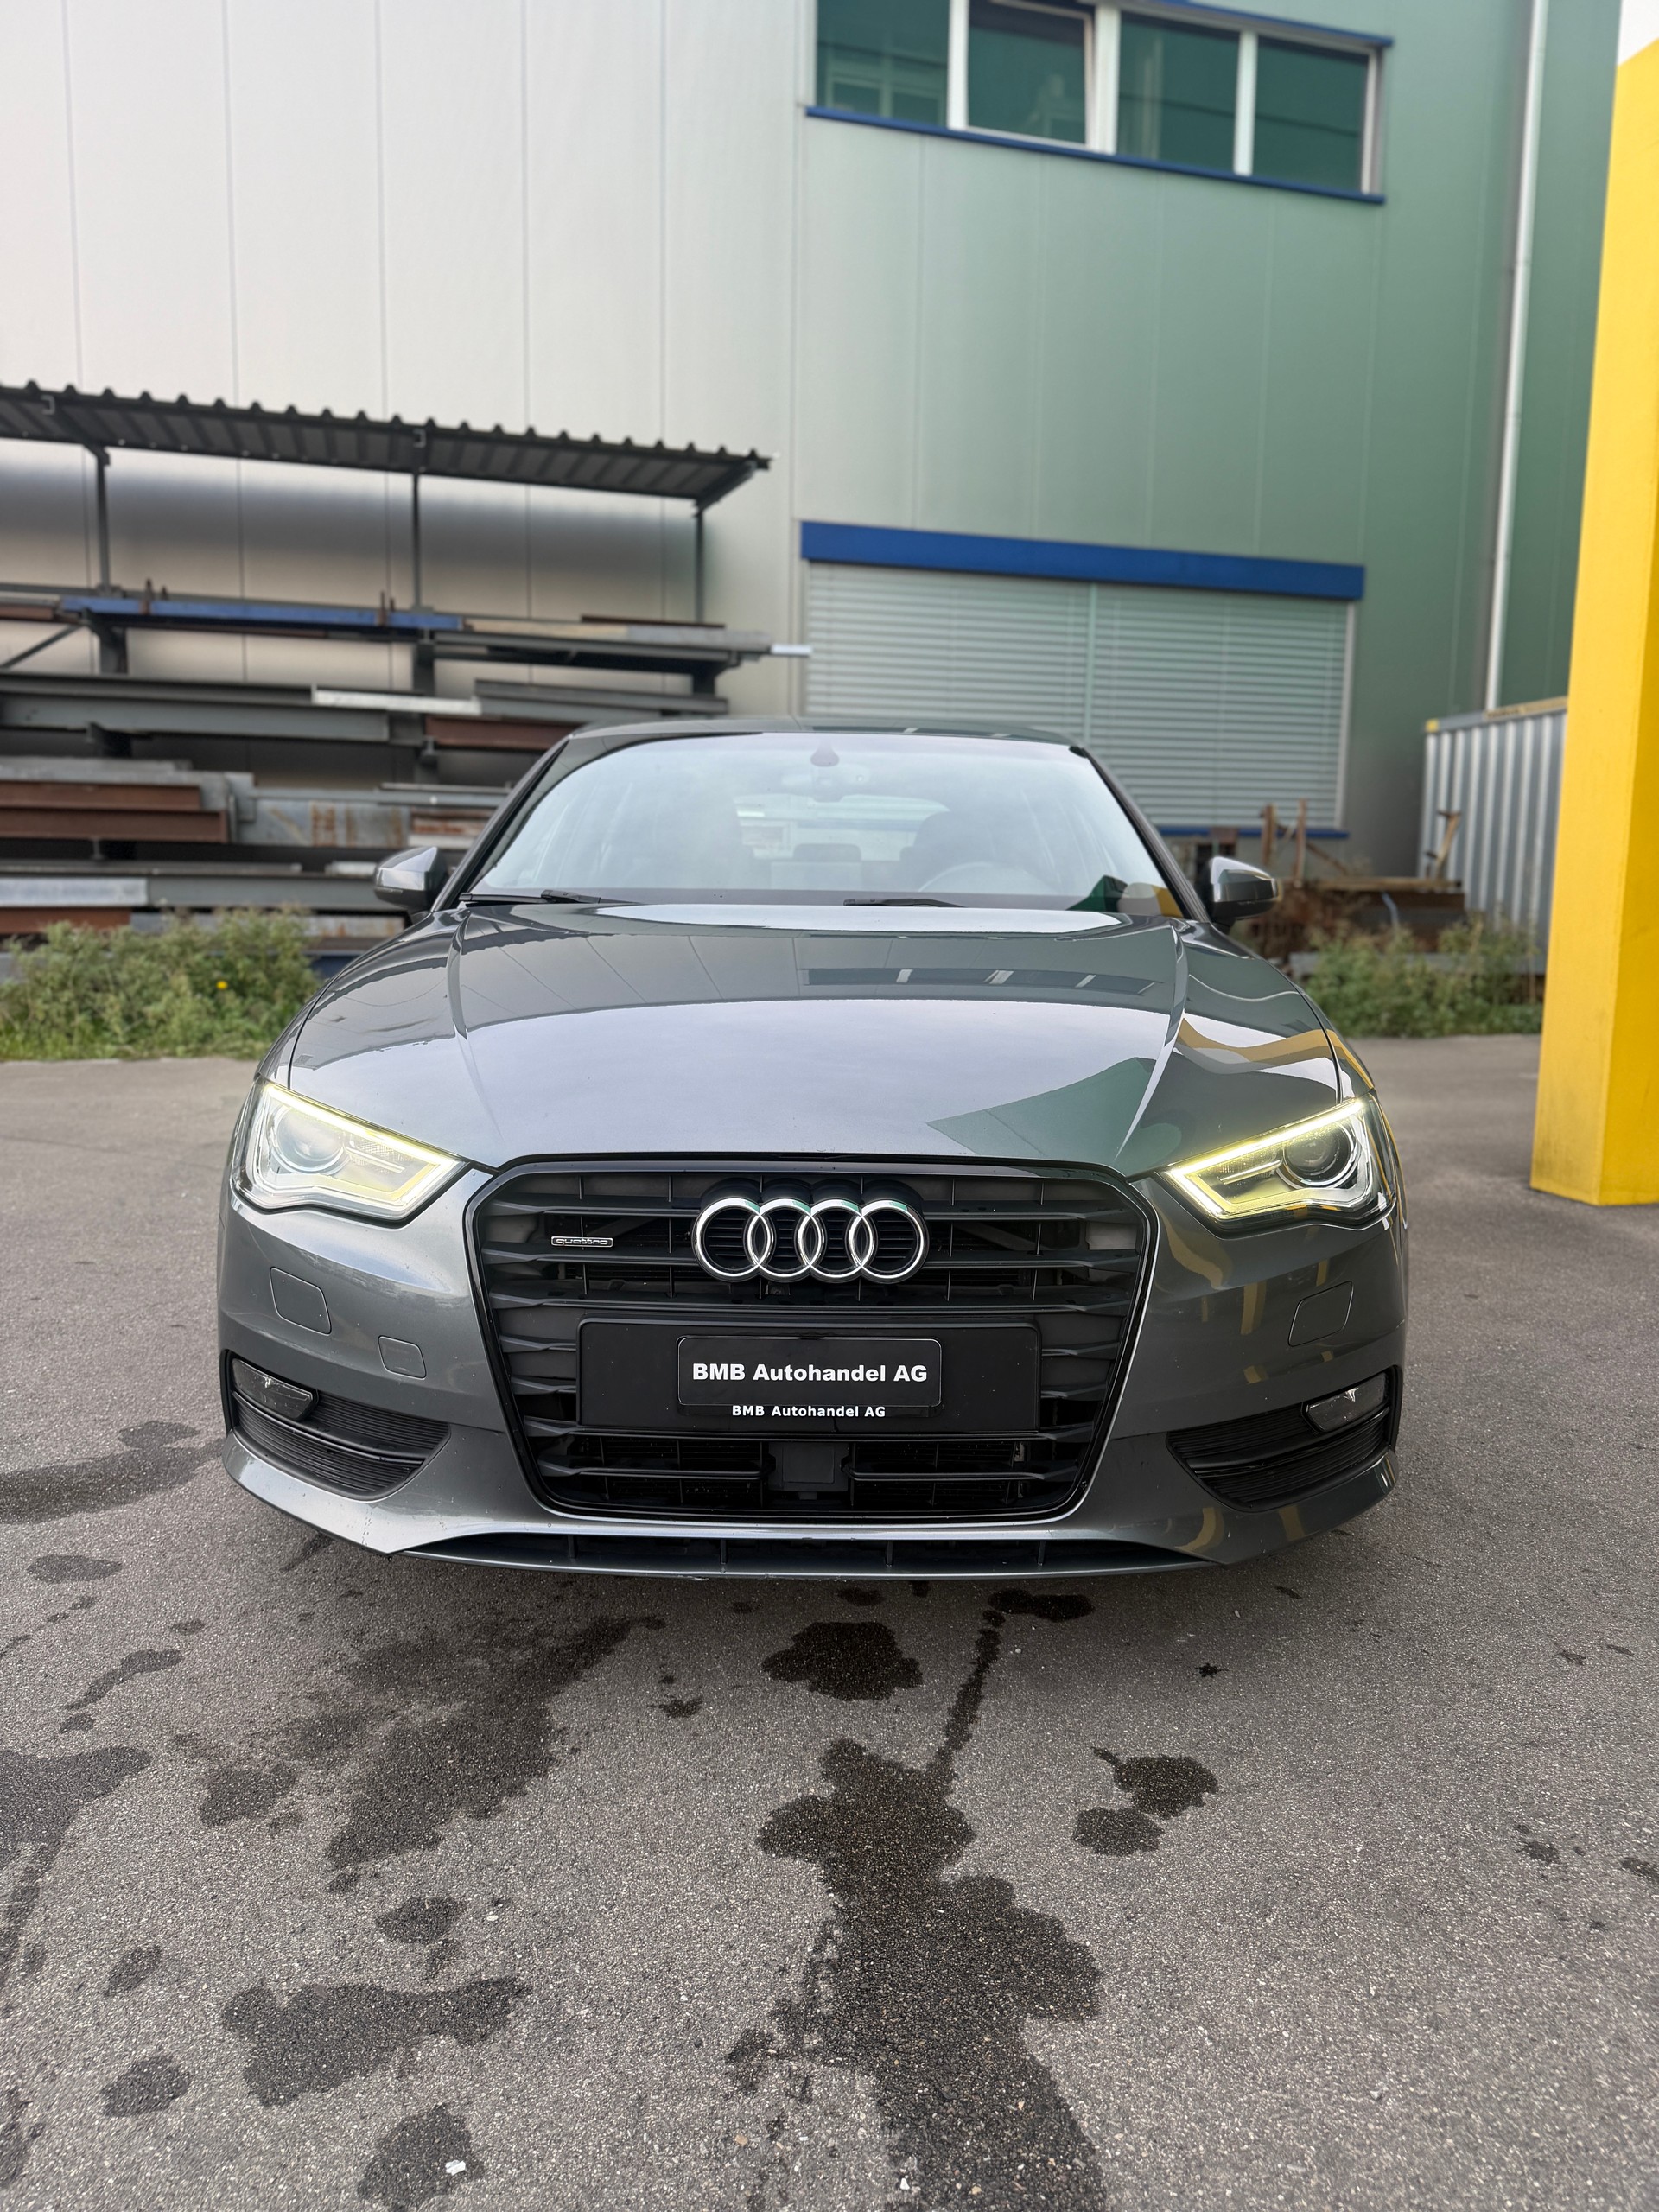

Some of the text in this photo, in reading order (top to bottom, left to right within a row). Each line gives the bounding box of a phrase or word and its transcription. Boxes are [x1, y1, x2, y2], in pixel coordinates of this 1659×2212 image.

[692, 1363, 927, 1382] BMB Autohandel AG
[732, 1404, 886, 1418] BMB Autohandel AG
